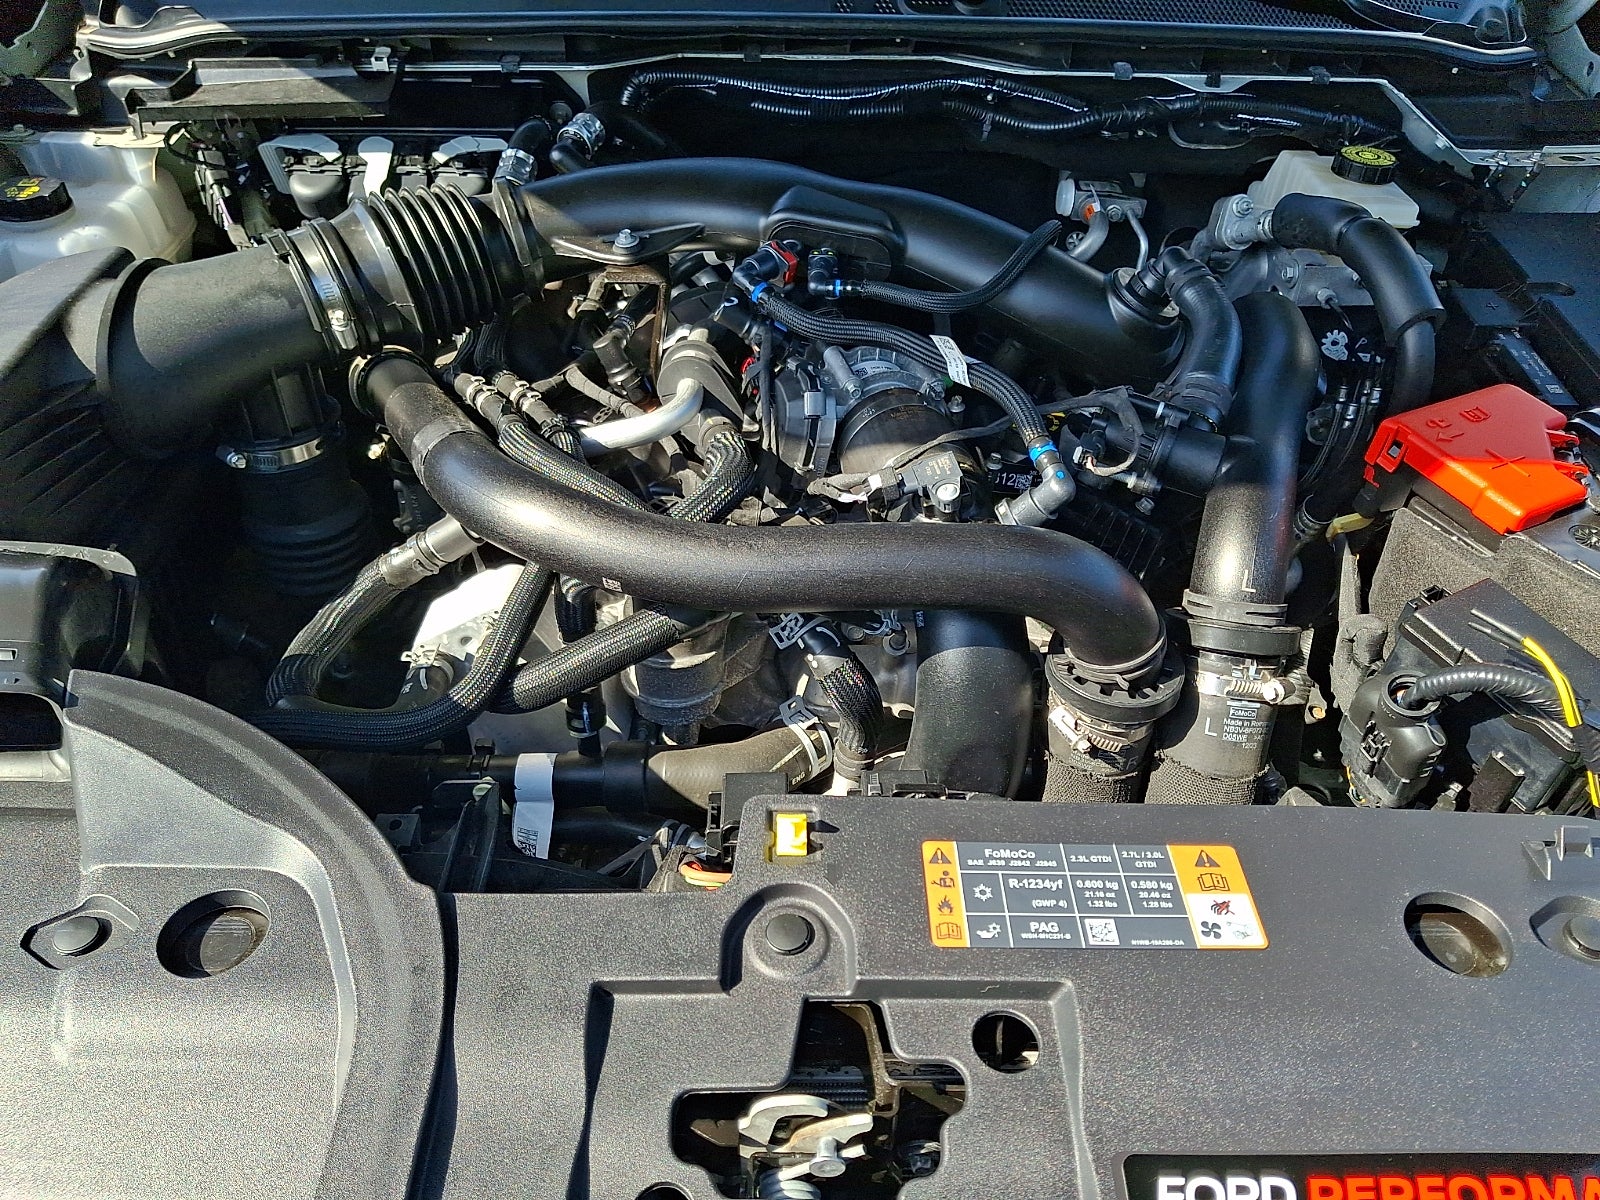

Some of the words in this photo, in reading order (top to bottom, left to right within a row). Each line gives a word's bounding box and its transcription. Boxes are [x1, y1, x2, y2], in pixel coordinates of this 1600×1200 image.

[1241, 569, 1256, 593] L
[1230, 708, 1256, 718] FoMoCo
[1204, 716, 1218, 737] L
[1223, 717, 1243, 728] Made
[984, 848, 1036, 859] FoMoCo
[1121, 851, 1141, 859] 2.7L
[1145, 851, 1165, 859] 3.0L
[1069, 855, 1090, 863] 2.3L
[1008, 878, 1063, 891] R-1234yf
[1076, 880, 1104, 889] 0.600
[1105, 880, 1119, 890] kg
[1130, 880, 1158, 889] 0.580
[1159, 881, 1174, 890] kg
[1032, 899, 1056, 908] (GWP
[1058, 900, 1068, 909] 4)
[1087, 900, 1104, 908] 1.32
[1105, 900, 1118, 908] lbs
[1029, 922, 1060, 933] PAG
